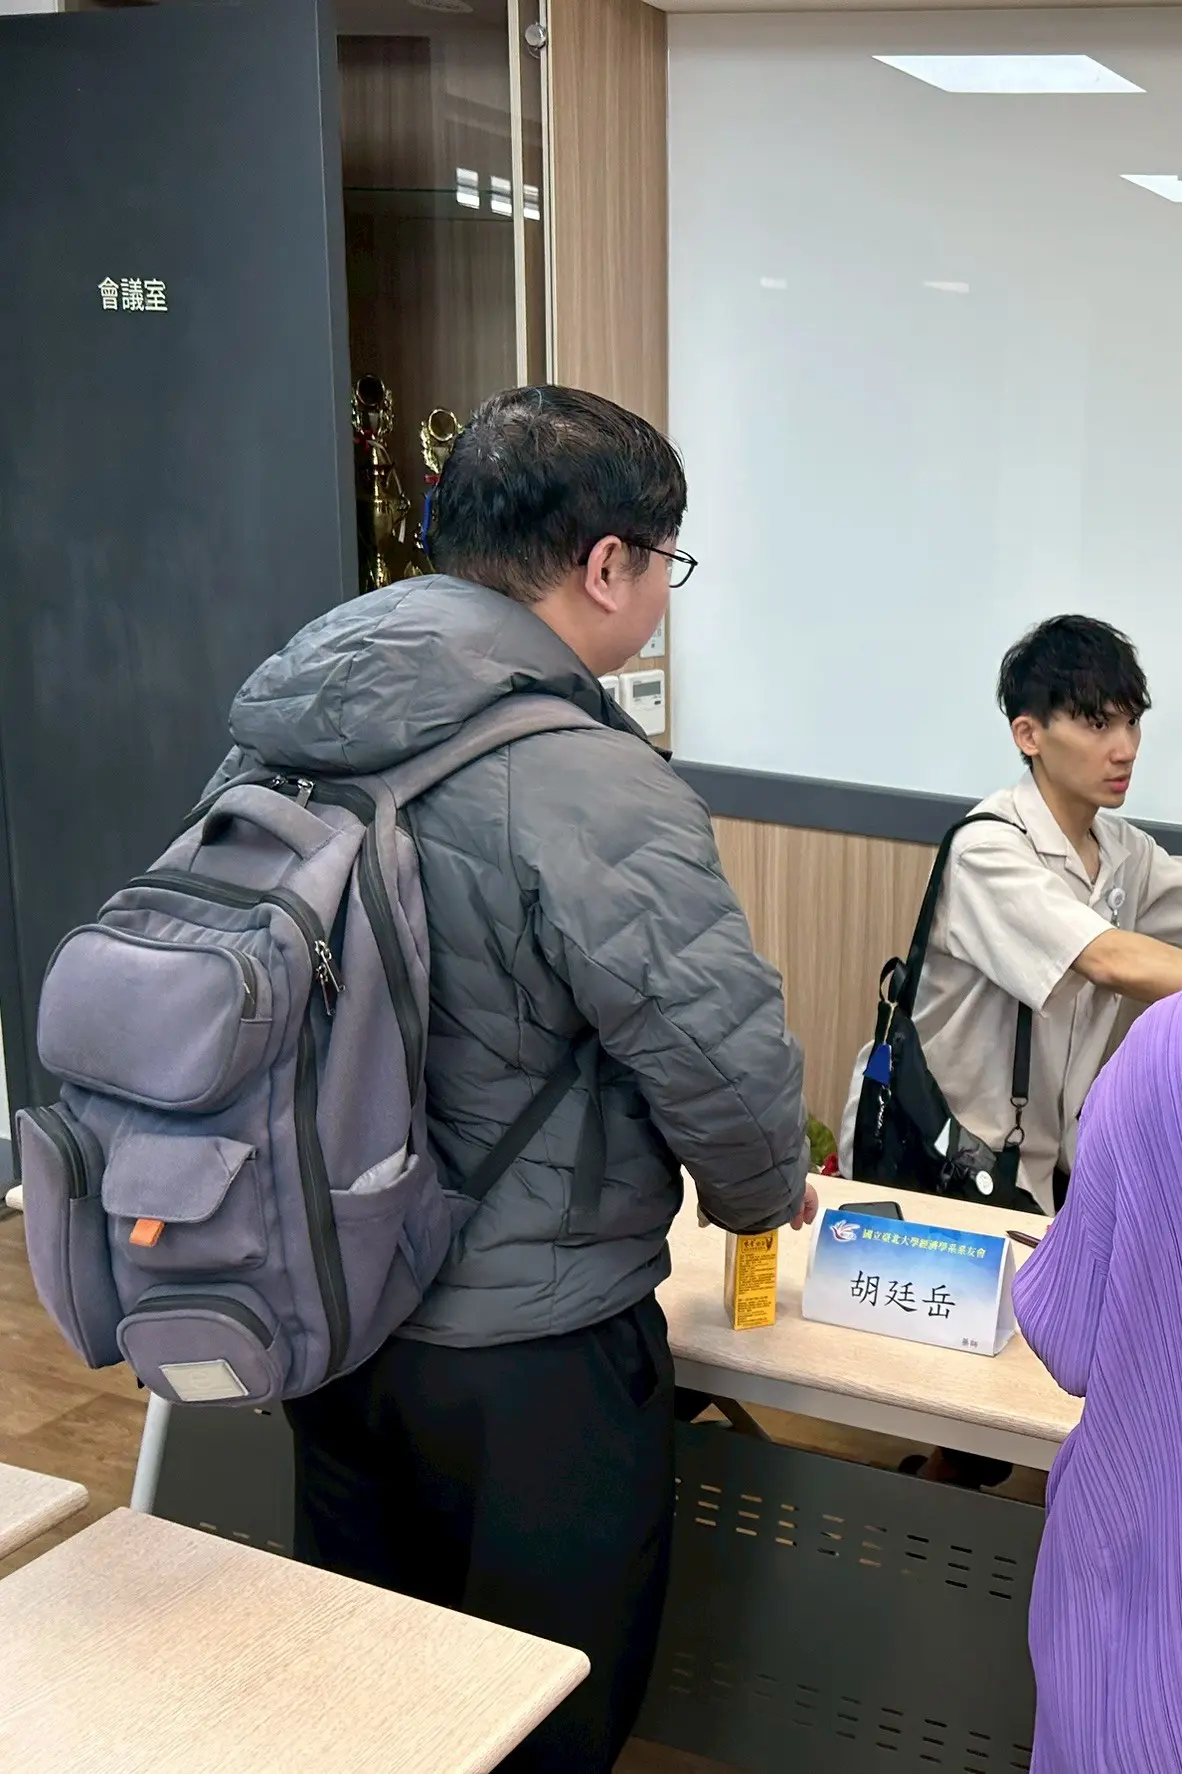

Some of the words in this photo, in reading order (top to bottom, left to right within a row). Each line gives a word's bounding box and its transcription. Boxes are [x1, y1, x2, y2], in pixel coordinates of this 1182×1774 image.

[98, 277, 168, 311] 會議室
[850, 1270, 956, 1319] 胡廷岳
